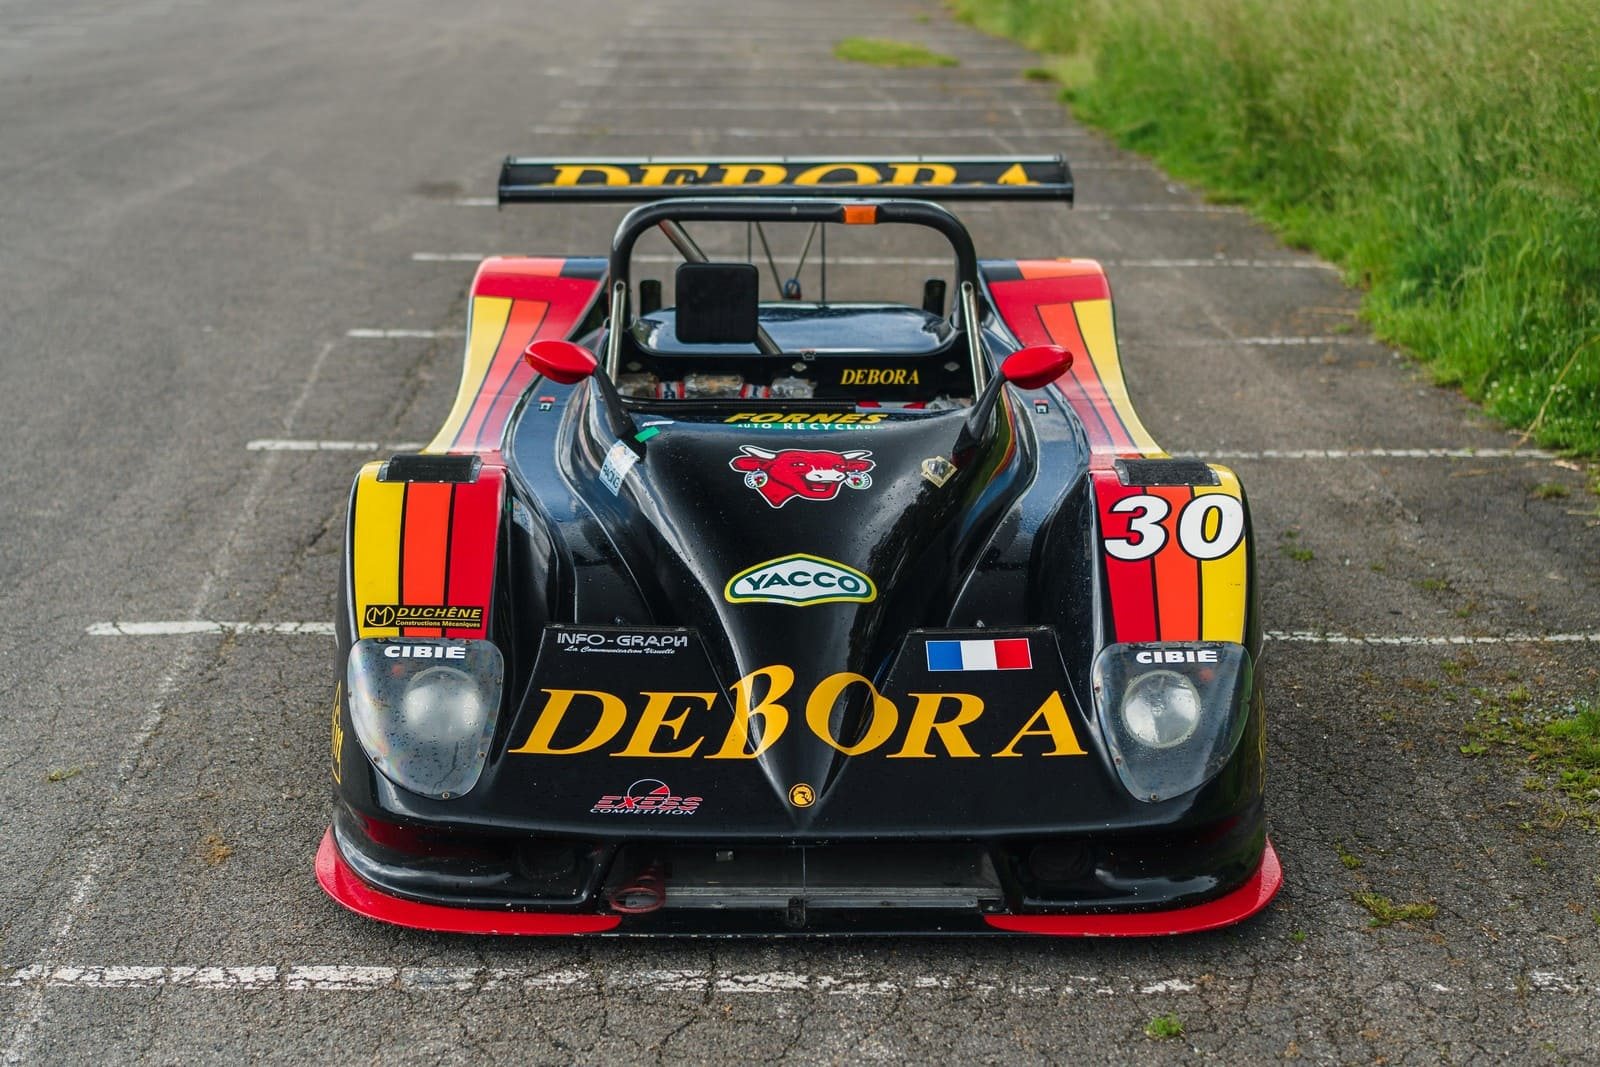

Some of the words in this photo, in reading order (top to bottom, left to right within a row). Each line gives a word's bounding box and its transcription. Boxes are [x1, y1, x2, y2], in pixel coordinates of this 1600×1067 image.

[840, 368, 920, 385] DEBORA
[724, 412, 889, 424] FORNES
[1104, 493, 1246, 562] 30
[745, 570, 861, 593] YACCO
[397, 606, 482, 618] DUCHÊNE
[442, 620, 481, 629] Mécaniques
[557, 632, 688, 647] INFO-GRAPH
[580, 645, 643, 654] Communication
[508, 664, 1088, 758] DEBORA
[594, 795, 704, 811] EXESS
[589, 808, 697, 816] COMPETITION
